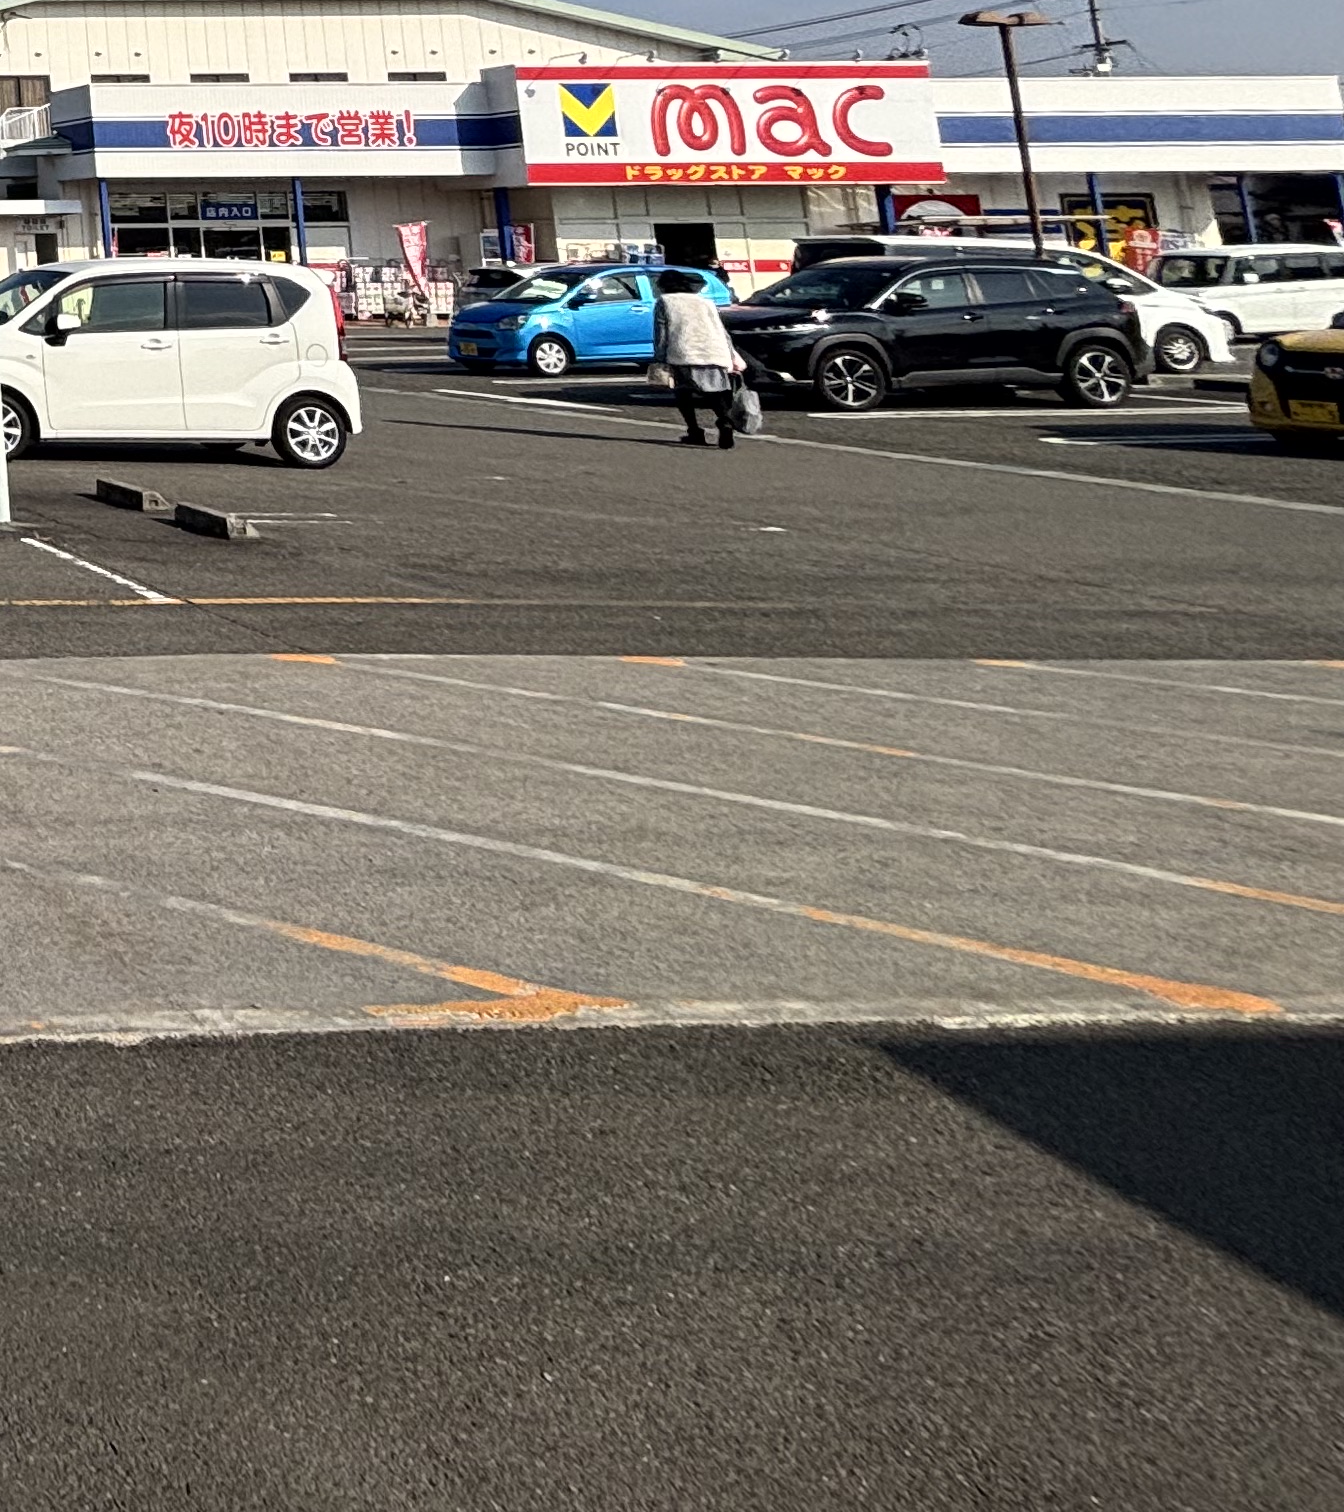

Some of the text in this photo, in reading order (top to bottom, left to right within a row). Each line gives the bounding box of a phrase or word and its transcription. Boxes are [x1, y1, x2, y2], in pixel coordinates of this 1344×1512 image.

[168, 109, 416, 147] 夜10時まで営業!
[651, 84, 893, 156] mac
[565, 142, 621, 157] POINT
[625, 165, 847, 181] ドラッグストア マック
